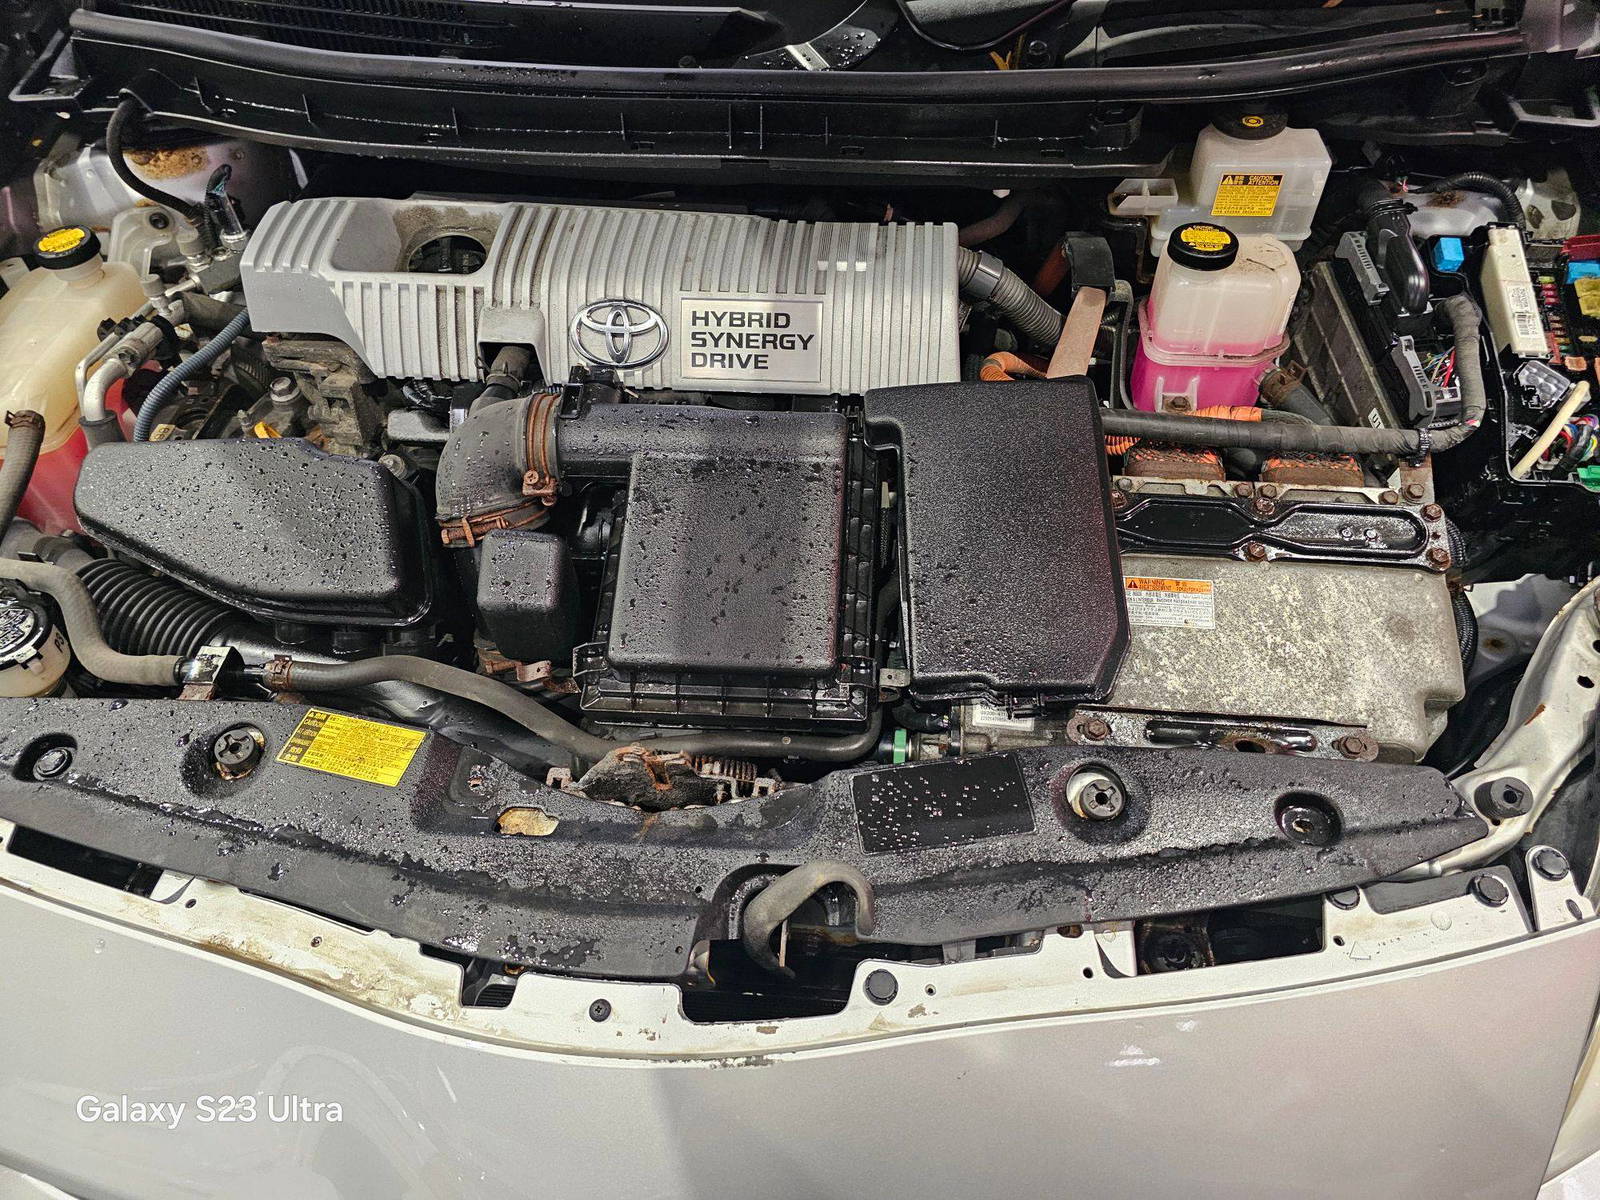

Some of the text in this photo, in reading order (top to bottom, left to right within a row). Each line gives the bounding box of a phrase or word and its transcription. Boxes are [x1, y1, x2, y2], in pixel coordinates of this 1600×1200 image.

[691, 311, 790, 328] HYBRID
[691, 332, 814, 350] SYNERGY
[691, 353, 768, 369] DRIVE
